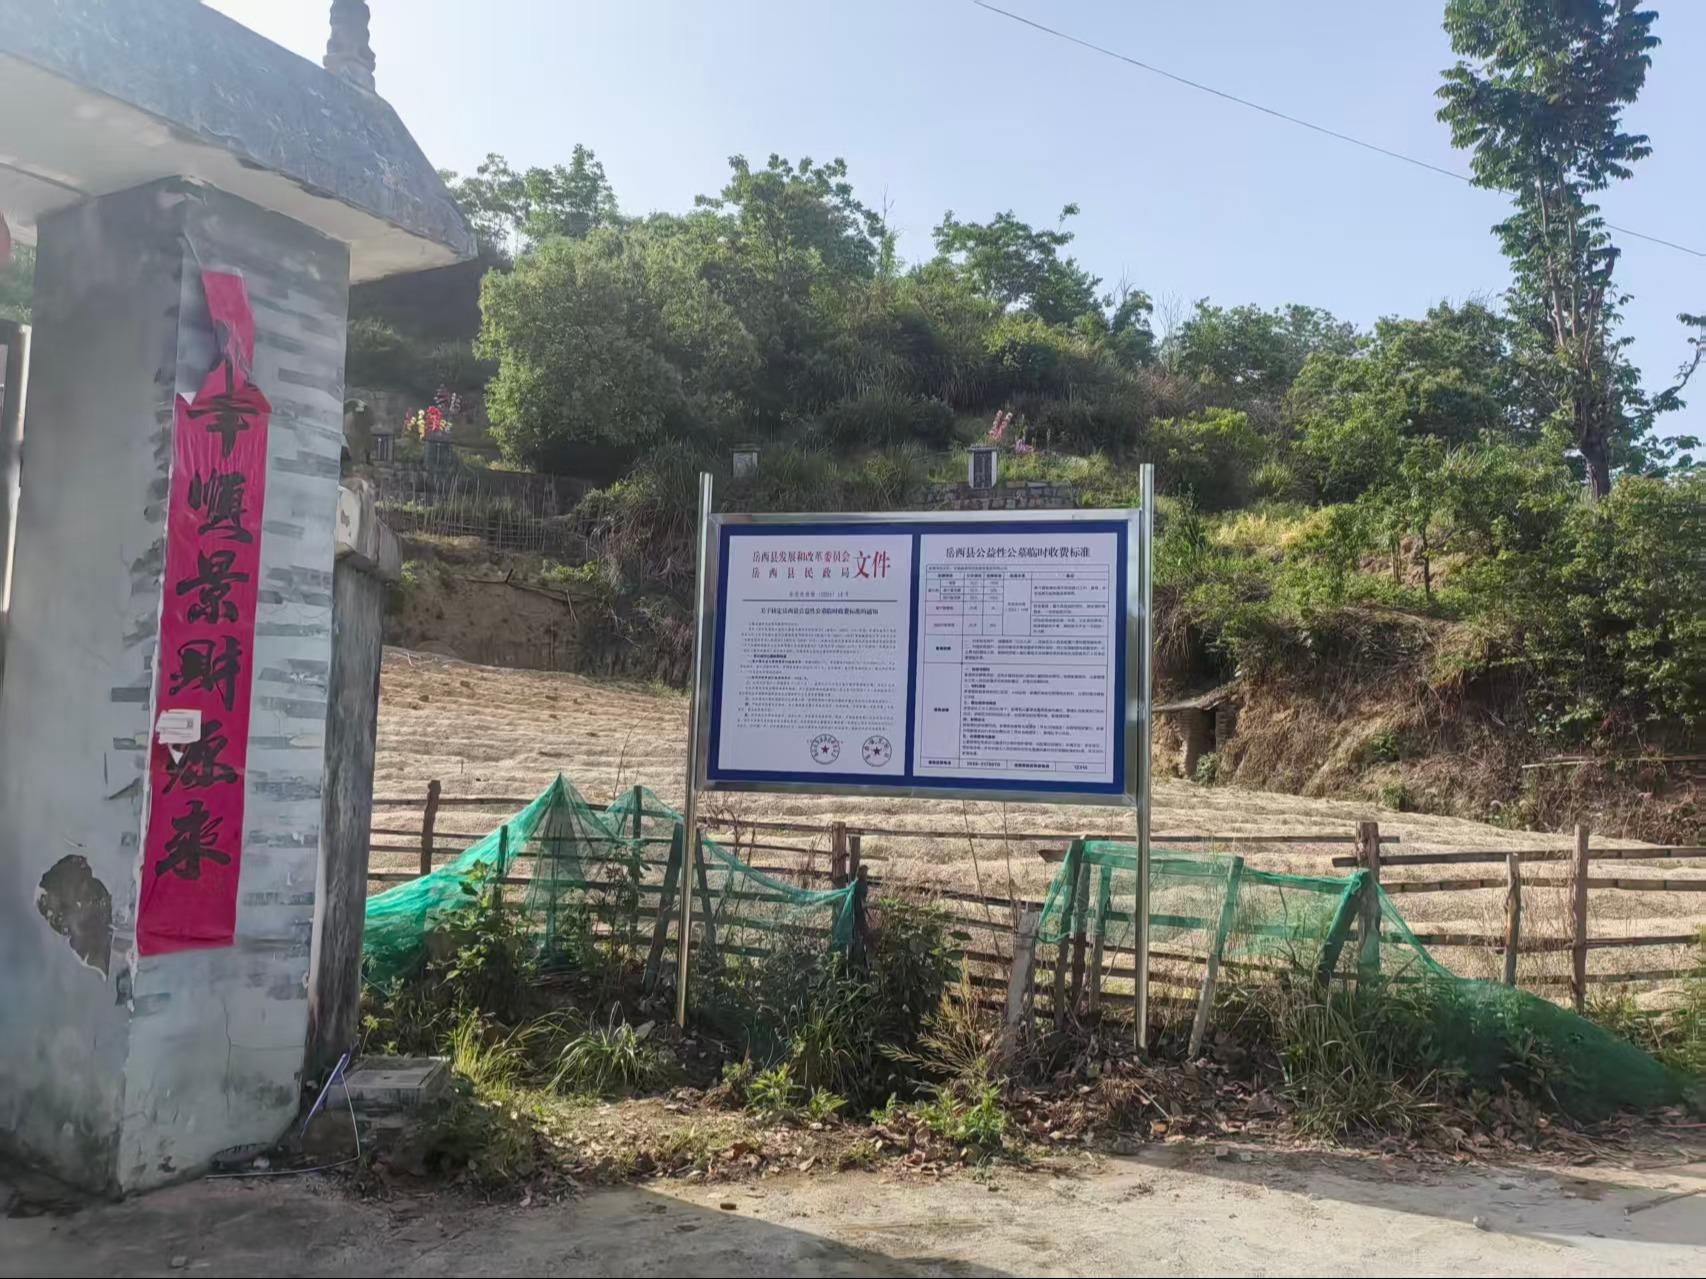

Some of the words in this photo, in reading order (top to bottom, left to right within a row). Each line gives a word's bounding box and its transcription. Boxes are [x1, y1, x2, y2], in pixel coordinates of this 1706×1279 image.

[752, 550, 850, 563] 岳西县发展和改革委员会
[946, 546, 1091, 559] 岳西县公益性公墓临时收费标准
[853, 550, 891, 579] 文件
[752, 566, 850, 579] 岳西县民政局
